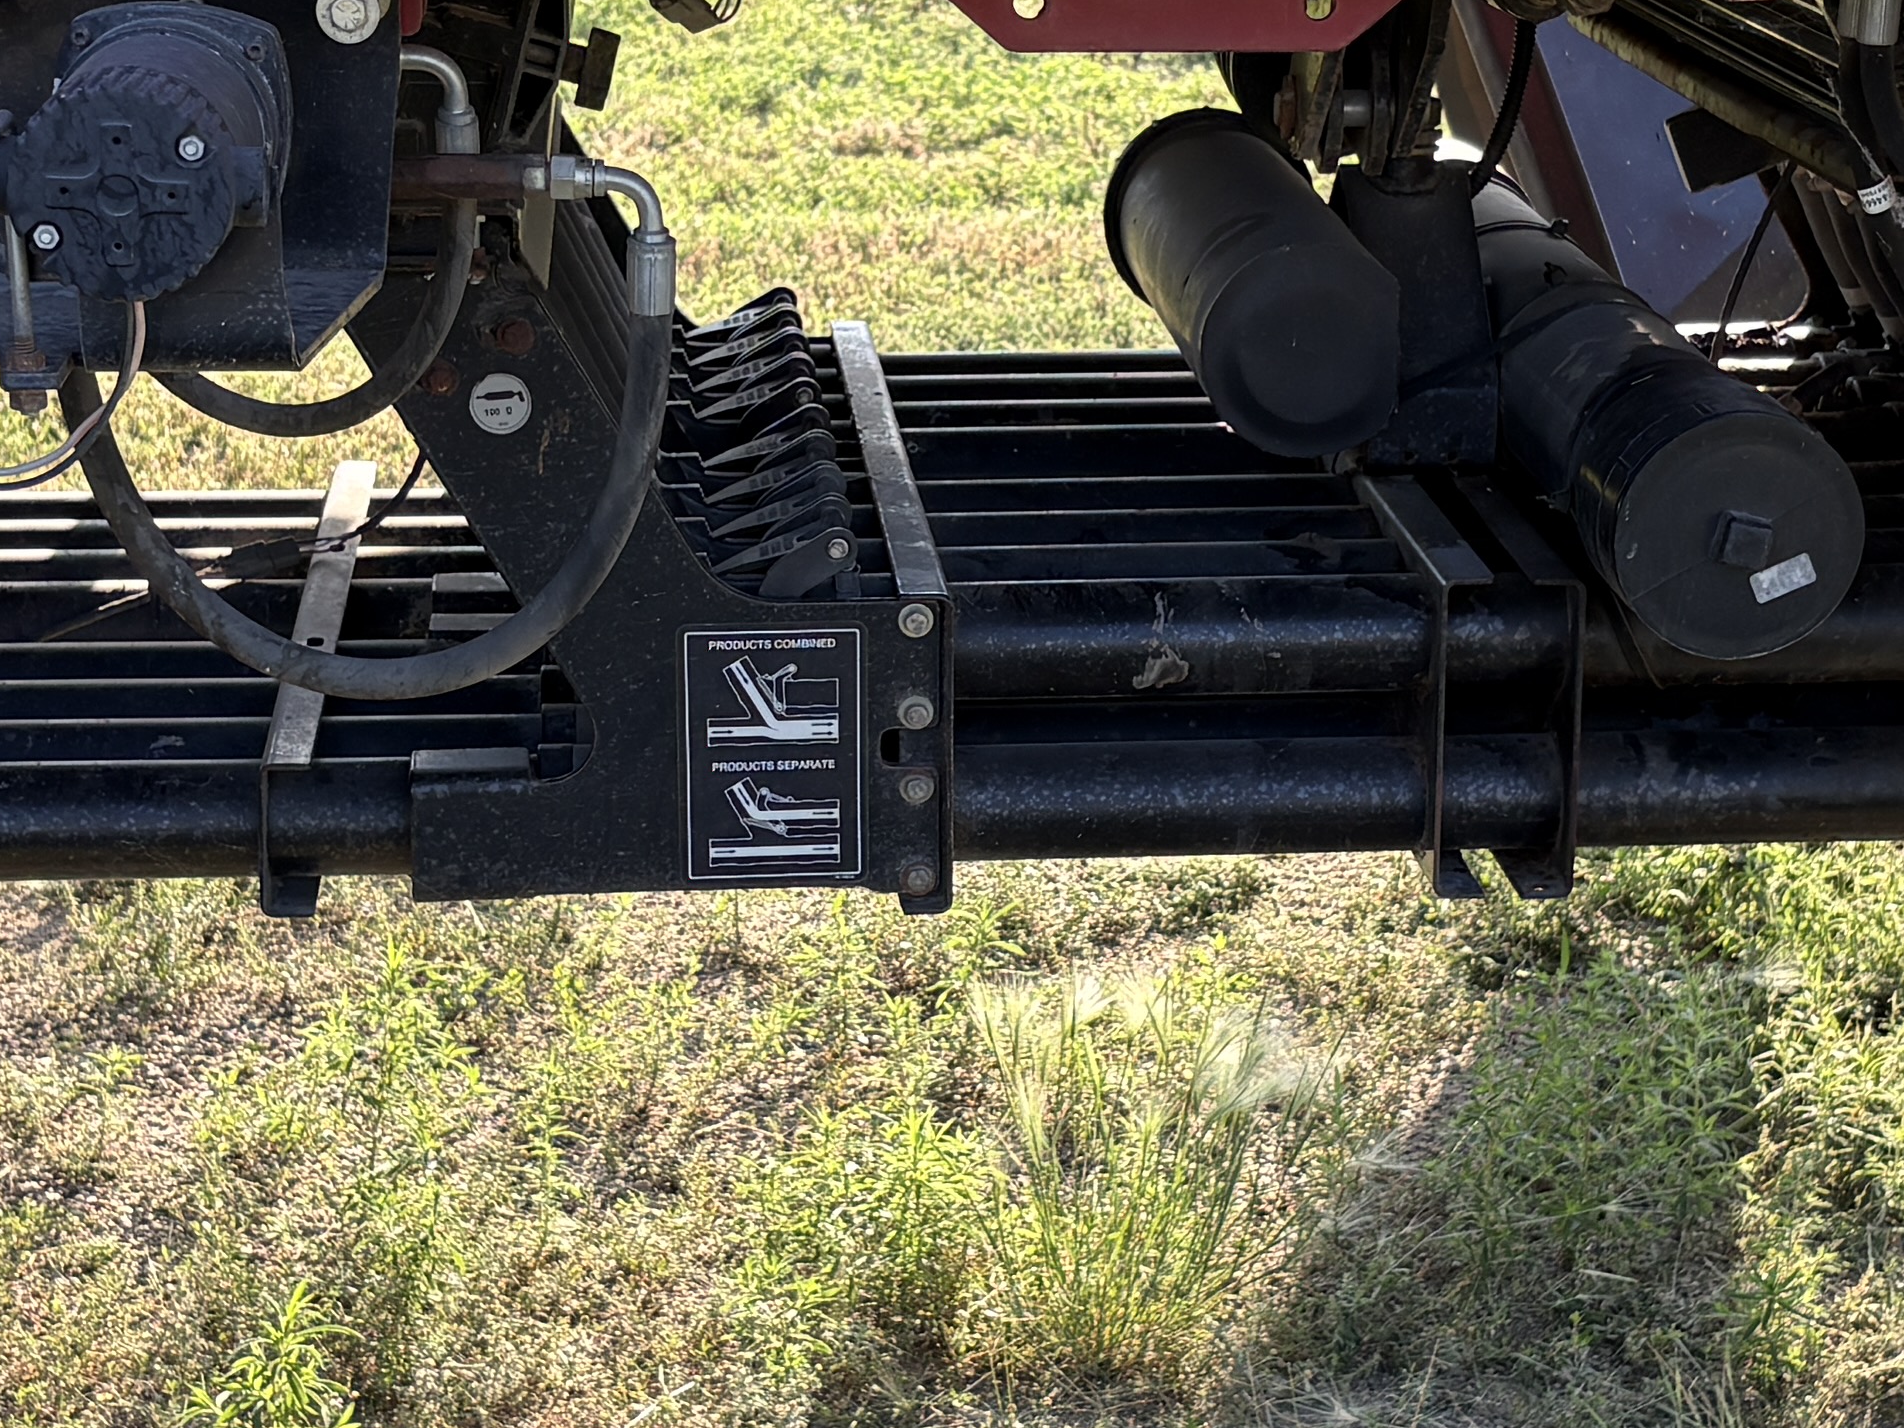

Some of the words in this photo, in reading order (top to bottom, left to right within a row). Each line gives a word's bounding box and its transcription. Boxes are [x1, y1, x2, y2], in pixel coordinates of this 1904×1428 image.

[708, 640, 772, 651] PRODUCTS
[774, 638, 836, 649] COMBINED
[712, 761, 775, 772] PRODUCTS
[777, 759, 836, 770] SEPARATE
